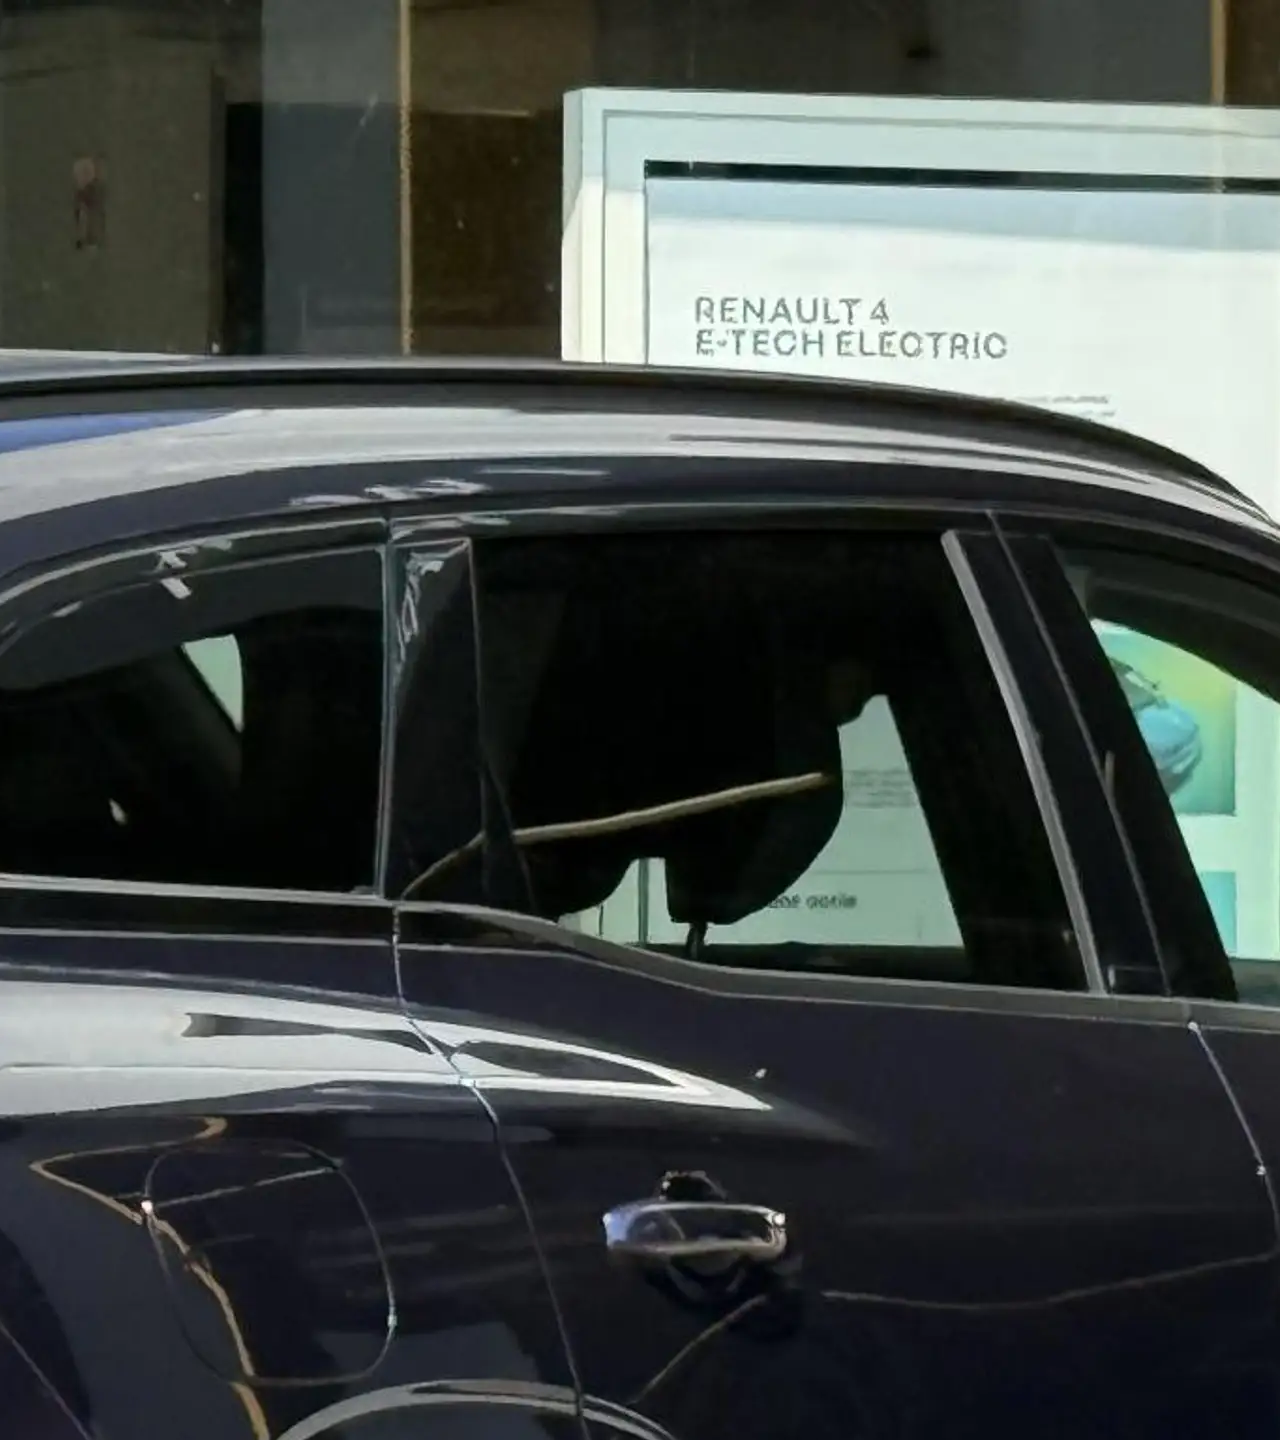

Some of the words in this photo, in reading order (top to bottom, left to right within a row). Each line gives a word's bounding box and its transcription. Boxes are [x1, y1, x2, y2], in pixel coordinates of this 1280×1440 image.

[694, 296, 861, 325] RENAULT
[869, 297, 890, 326] 4
[694, 328, 824, 357] E-TECH
[835, 330, 1008, 360] ELECTRIC
